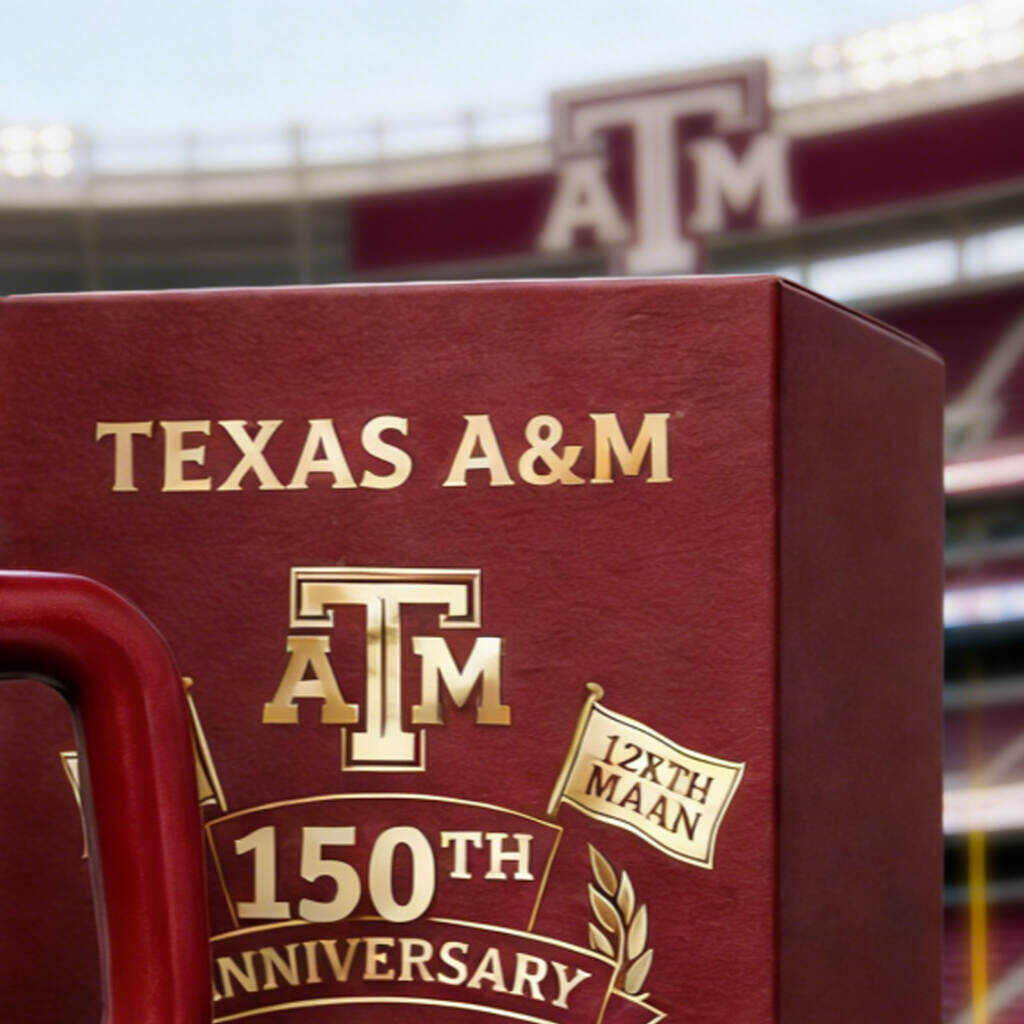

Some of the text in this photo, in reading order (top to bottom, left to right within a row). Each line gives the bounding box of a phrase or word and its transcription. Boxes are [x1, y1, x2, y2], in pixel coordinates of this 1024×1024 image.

[95, 413, 673, 492] TEXAS A&M
[585, 765, 702, 841] MAAN
[602, 734, 714, 806] 12XTH
[234, 826, 533, 923] 150TH
[213, 936, 592, 1011] NNIVERSARY
